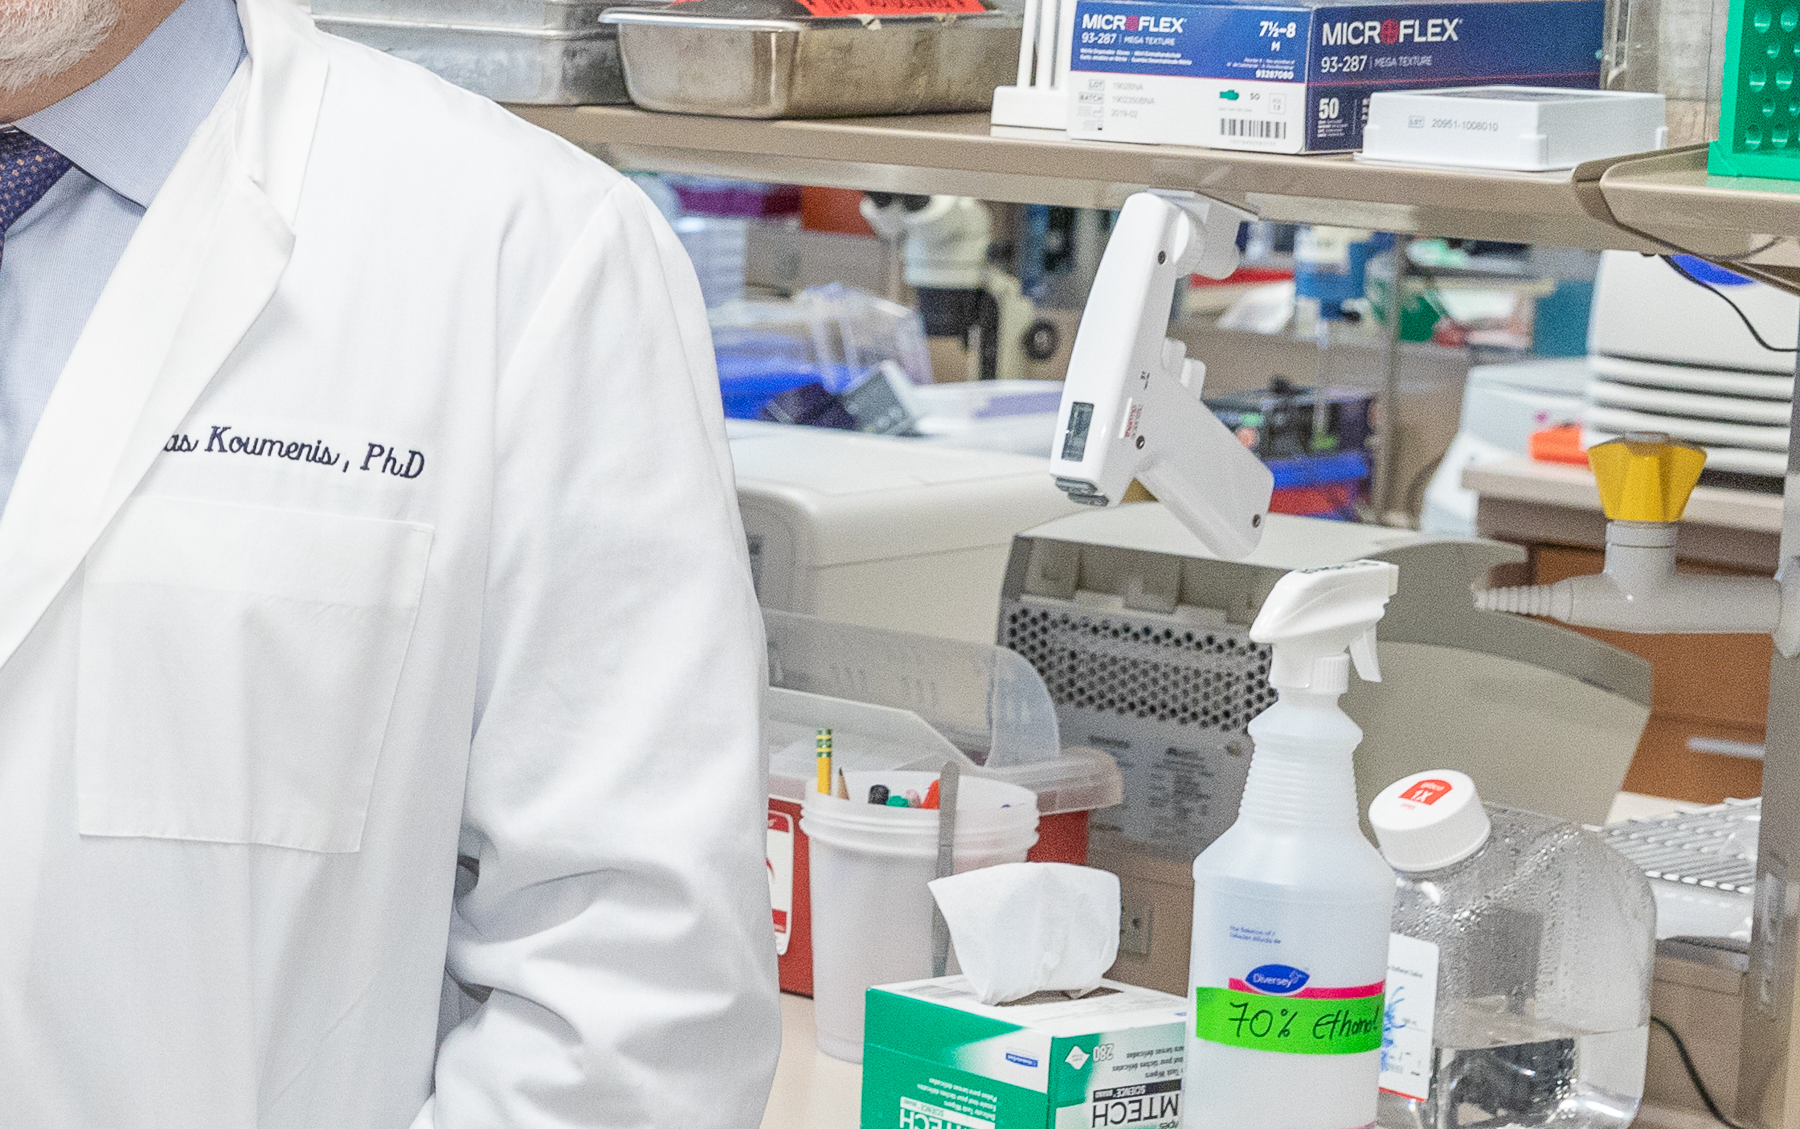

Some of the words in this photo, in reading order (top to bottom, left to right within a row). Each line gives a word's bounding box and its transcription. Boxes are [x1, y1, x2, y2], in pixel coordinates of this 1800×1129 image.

[1081, 32, 1117, 45] 93-287
[1124, 35, 1143, 45] MEGA
[1146, 36, 1175, 46] TEXTURE
[1321, 55, 1368, 73] 93-287
[1375, 57, 1396, 68] MEGA
[1399, 55, 1432, 67] TEXTURE
[1318, 97, 1339, 120] 50
[360, 442, 425, 479] PhD
[1411, 789, 1434, 802] 1X
[1252, 972, 1292, 988] Diversey
[1228, 1001, 1298, 1039] 70%
[1312, 1005, 1380, 1040] Ethanol
[1092, 1043, 1114, 1061] 280
